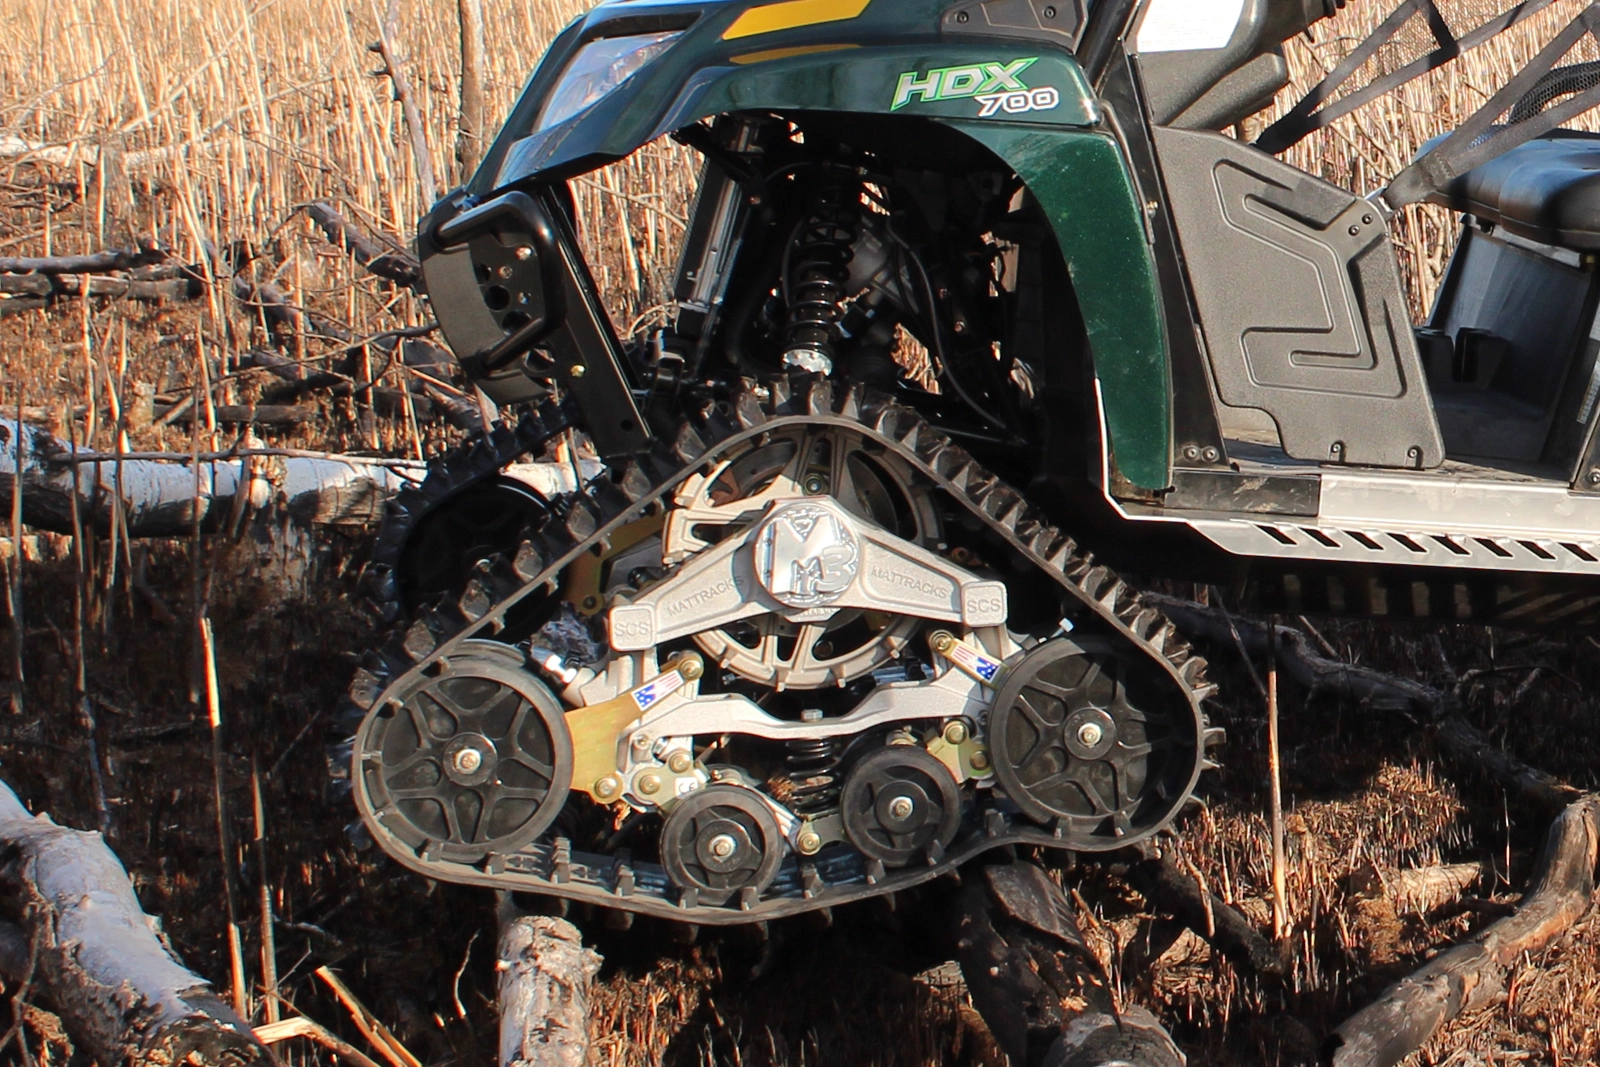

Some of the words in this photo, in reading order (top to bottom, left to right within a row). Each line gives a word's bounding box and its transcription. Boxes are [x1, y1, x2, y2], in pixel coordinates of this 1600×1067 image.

[890, 56, 1039, 112] HDX
[973, 87, 1059, 118] 700
[665, 575, 744, 617] MATTRACKS
[870, 564, 949, 600] MATTRACKS
[966, 597, 1002, 614] SCS
[614, 621, 651, 637] SCS
